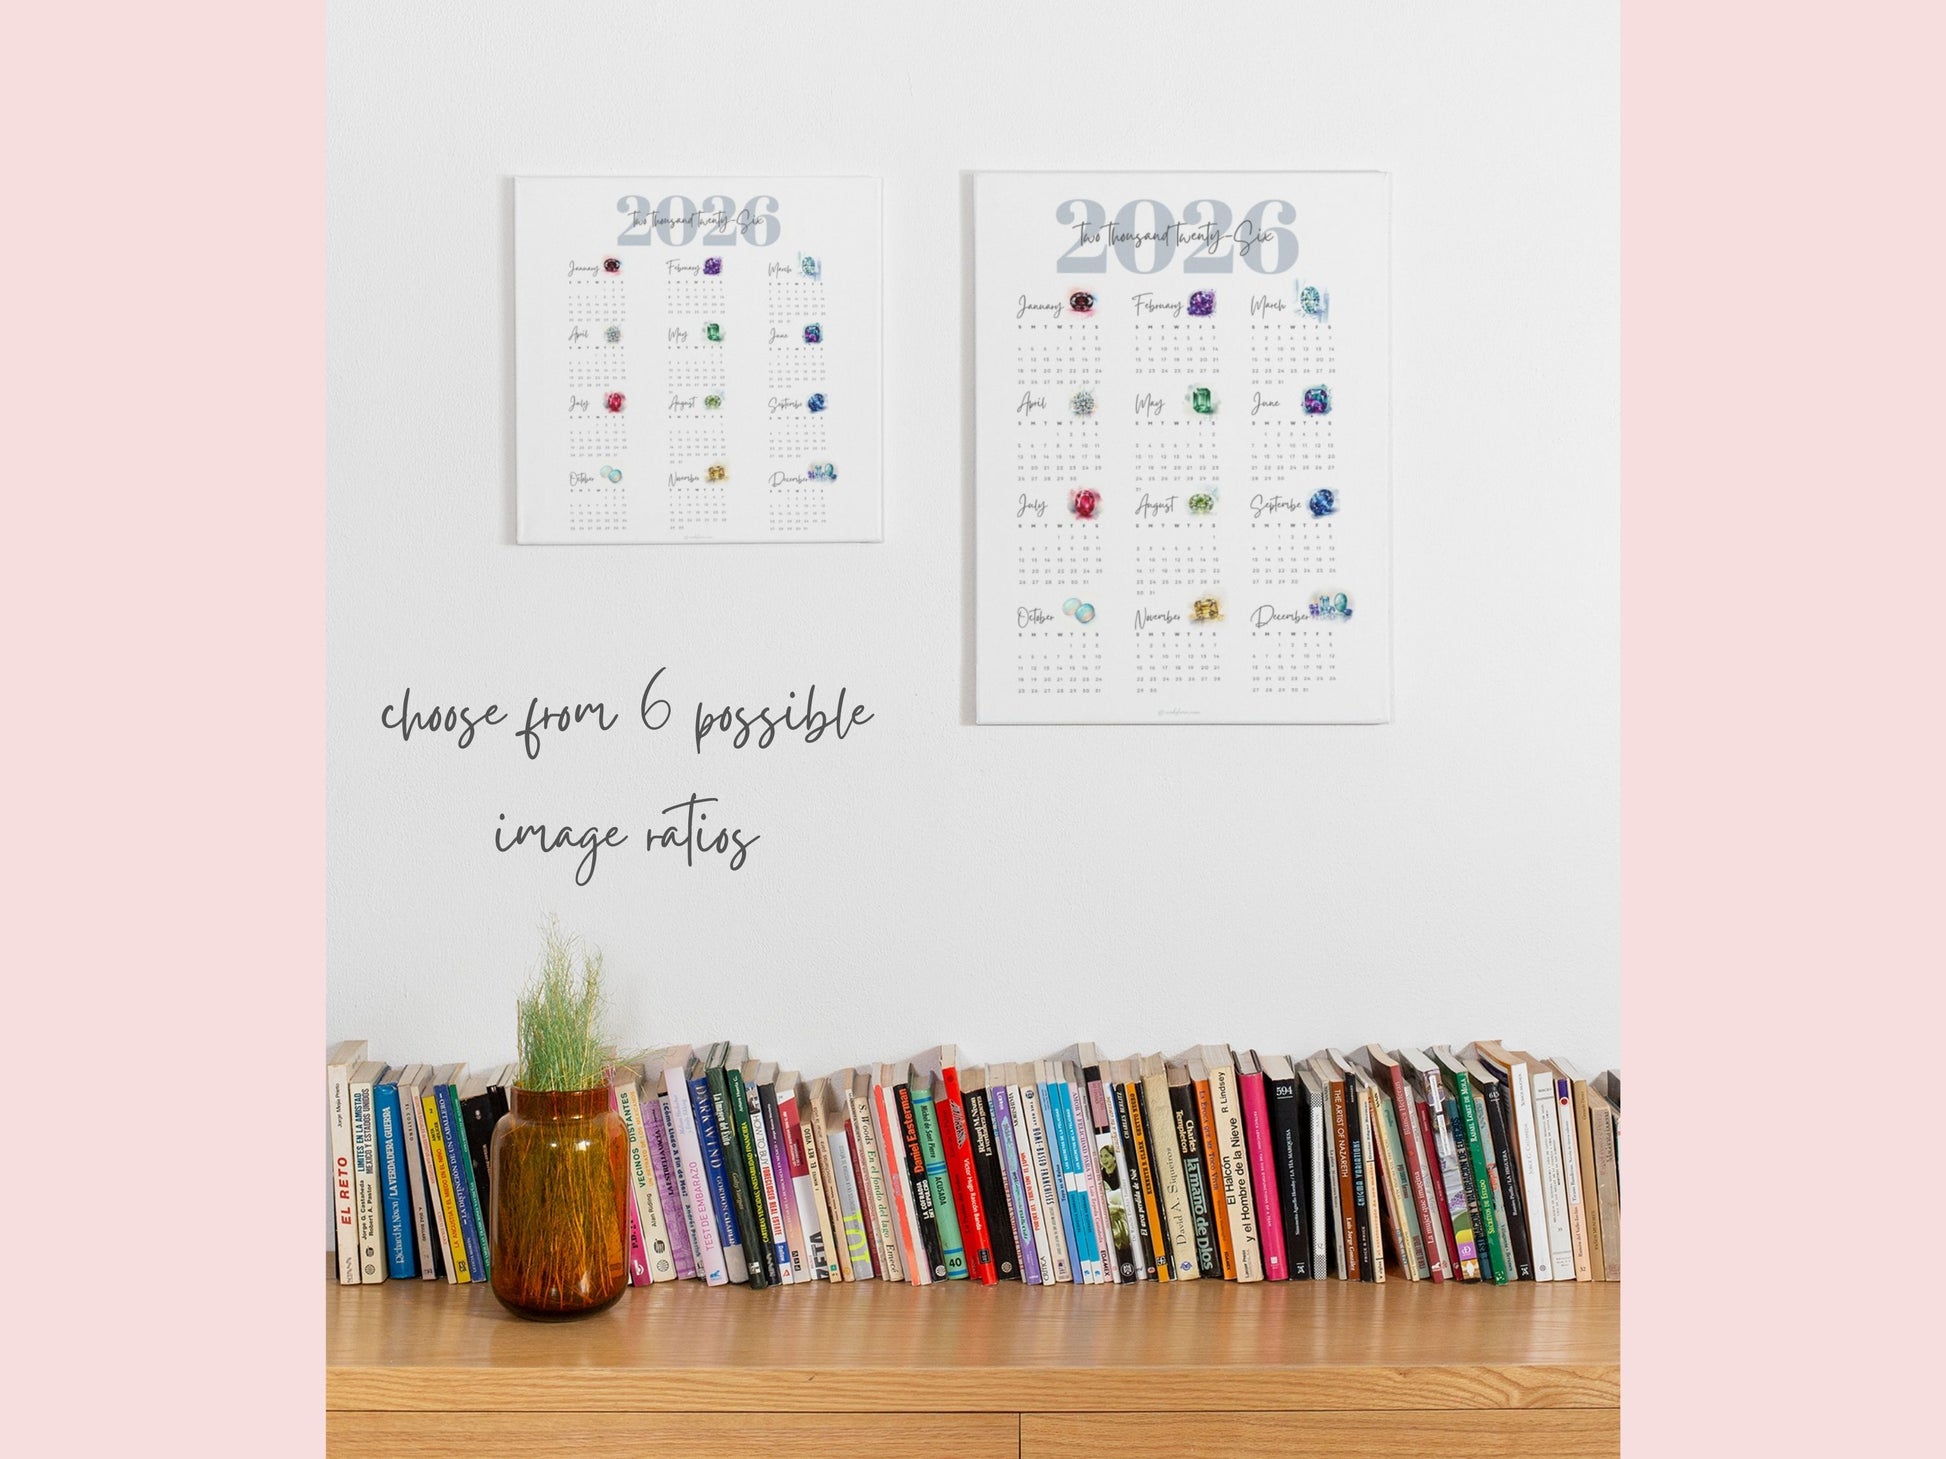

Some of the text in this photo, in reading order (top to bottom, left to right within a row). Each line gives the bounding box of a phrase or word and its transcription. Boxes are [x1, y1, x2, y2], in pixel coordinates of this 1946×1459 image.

[617, 194, 781, 247] 2026
[1056, 199, 1299, 274] 2026
[1017, 295, 1064, 318] January
[1132, 293, 1184, 317] February
[1251, 295, 1287, 318] March
[1017, 392, 1047, 414] April
[1136, 394, 1166, 416] May
[1252, 392, 1280, 415] June
[1017, 494, 1048, 517] July
[1135, 493, 1178, 518] August
[1017, 607, 1054, 628] October
[1135, 608, 1181, 629] November
[1250, 604, 1309, 628] December
[361, 1088, 369, 1111] UNIDOS
[1129, 1092, 1137, 1112] NEGRO
[1217, 1071, 1228, 1104] Lindsey
[1276, 1086, 1292, 1096] 594
[438, 1098, 454, 1151] UN CABALLERO
[968, 1096, 985, 1152] Richard Nixon
[976, 1095, 990, 1147] verdadera guerra
[1335, 1103, 1343, 1126] ARTIST
[1400, 1111, 1410, 1135] Blanca
[1459, 1078, 1477, 1142] RAFAEL LORET MOLA
[353, 1092, 364, 1171] LIMITES EN LA AMISTAD
[363, 1113, 371, 1141] ESTADOS
[620, 1092, 646, 1187] VECINOS DISTANTES
[694, 1084, 722, 1168] DARK WIND
[861, 1115, 873, 1145] Woods
[897, 1087, 924, 1173] Daniel Easterman
[920, 1104, 937, 1158] Michel Pierre
[1072, 1091, 1091, 1172] AMOR FELICIDAD PARA
[1120, 1114, 1129, 1138] CHARLES
[1174, 1109, 1188, 1153] Templeton
[1184, 1119, 1197, 1152] Charles
[1337, 1127, 1344, 1138] OF
[867, 1149, 877, 1162] En
[1285, 1128, 1293, 1158] MARQUESA
[1338, 1139, 1348, 1177] NAZARETH
[658, 1150, 671, 1185] ESTRELLA
[677, 1169, 684, 1178] de
[752, 1115, 782, 1236] HOW TO BUY FORECLOSED REAL ESTATE
[870, 1165, 879, 1173] el
[1032, 1127, 1054, 1205] HOME-BASED FRANCHISES
[1137, 1140, 1152, 1194] KENNETH CLARK
[1220, 1155, 1234, 1192] Halcón
[1227, 1117, 1255, 1242] y el Hombre de la Nieve
[1352, 1140, 1364, 1206] ENIGMA VARIATIONS
[337, 1156, 351, 1225] EL RETO
[381, 1106, 404, 1263] Richard Nixon VERDADERA GUERRA
[715, 1175, 728, 1211] GORDON
[871, 1175, 883, 1201] fondo
[922, 1179, 932, 1207] SEPULCRO
[933, 1176, 947, 1205] ACUSADA
[1161, 1146, 1186, 1245] David A. Siqueiros
[1226, 1194, 1235, 1205] El
[645, 1193, 656, 1227] Alan Riding
[688, 1161, 714, 1250] TEST DE EMBARAZO
[877, 1203, 887, 1217] del
[922, 1211, 929, 1219] LA
[965, 1176, 982, 1230] Hugo Rascón Banda
[1133, 1190, 1144, 1213] perdida
[1186, 1157, 1215, 1271] la mano de Dios
[1412, 1170, 1434, 1244] La mujer que imagina
[1478, 1178, 1495, 1234] SECRETOS ESTADO
[447, 1210, 458, 1238] ANGUSTIA
[880, 1219, 891, 1238] lago
[949, 1258, 962, 1267] 40
